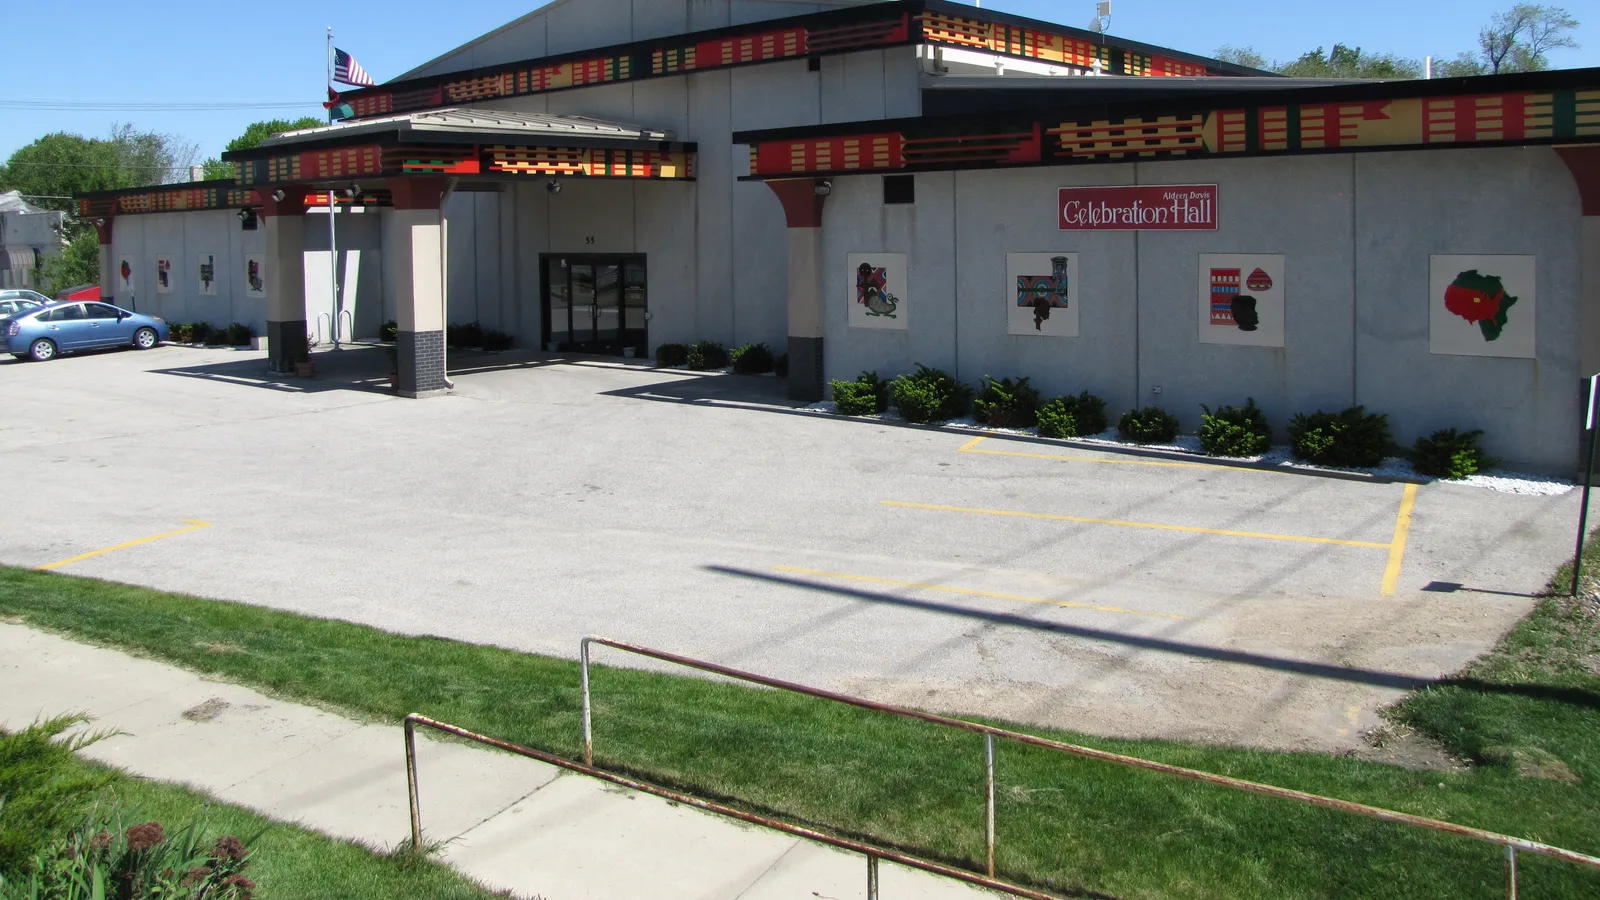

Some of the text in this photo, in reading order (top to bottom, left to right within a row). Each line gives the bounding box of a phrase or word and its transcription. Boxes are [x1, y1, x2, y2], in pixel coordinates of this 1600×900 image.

[1163, 190, 1211, 200] Aldeen Davis
[1063, 199, 1212, 227] Celebration Hall
[585, 236, 595, 245] 55
